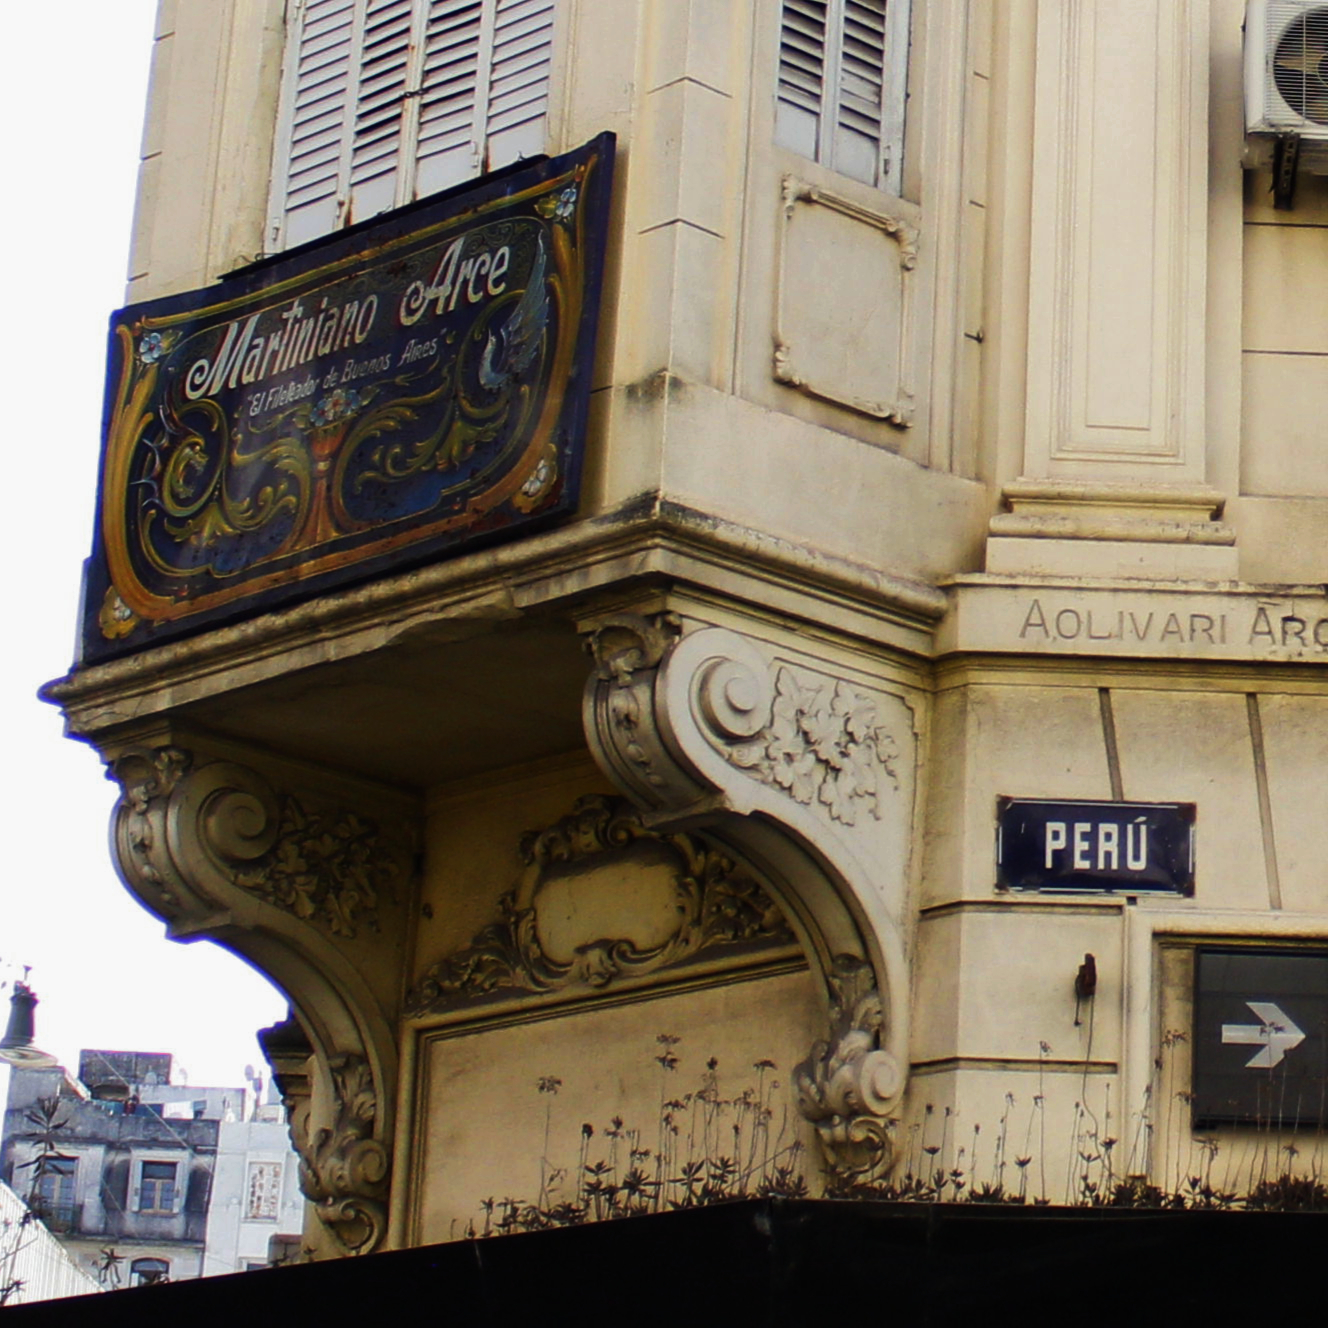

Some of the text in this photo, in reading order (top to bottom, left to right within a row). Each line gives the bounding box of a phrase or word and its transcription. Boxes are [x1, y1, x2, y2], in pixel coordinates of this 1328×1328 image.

[185, 236, 510, 400] Martiniano Arce
[322, 366, 338, 389] de
[340, 353, 391, 384] Buenos
[1045, 816, 1148, 871] PERÚ
